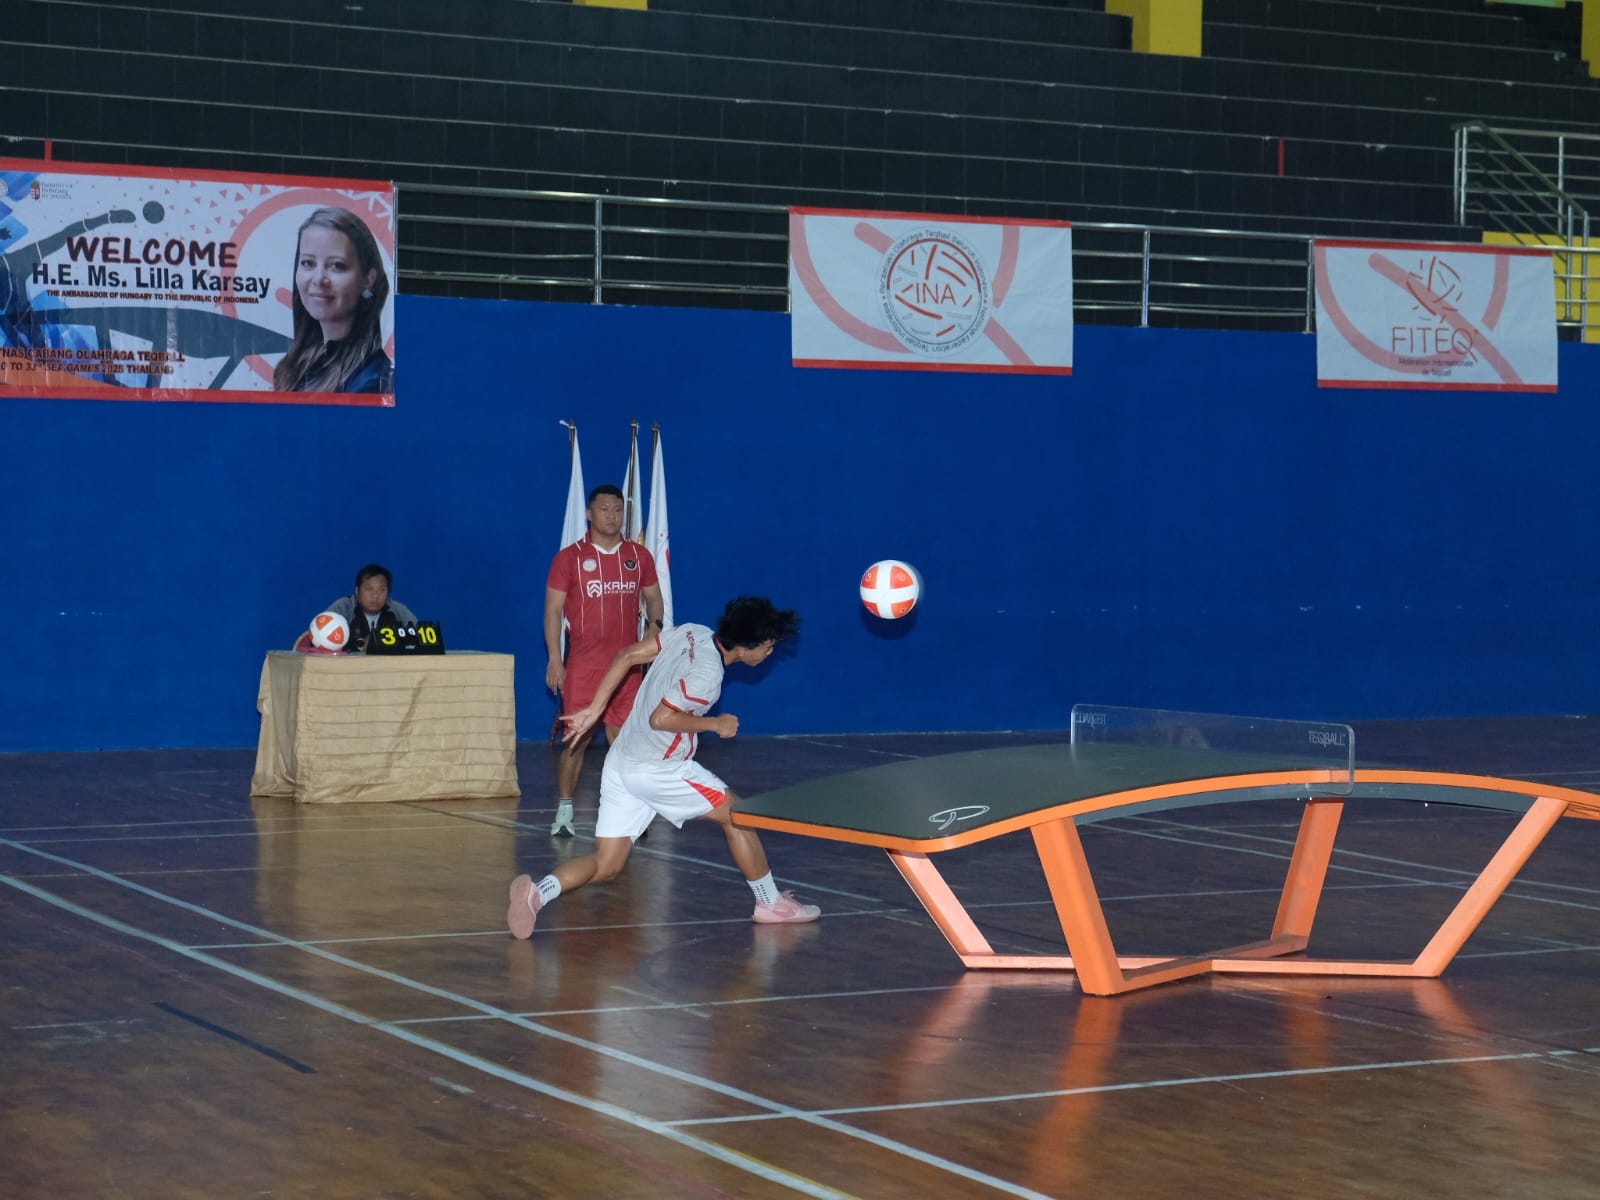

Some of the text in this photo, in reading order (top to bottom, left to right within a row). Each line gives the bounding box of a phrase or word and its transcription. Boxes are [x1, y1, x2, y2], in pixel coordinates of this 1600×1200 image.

[66, 235, 238, 268] WELCOME
[32, 262, 271, 299] H.E. Ms. Lilla Karsay
[46, 289, 60, 297] THE
[61, 290, 108, 298] AMBASSADOR
[120, 292, 152, 300] HUNGARY
[165, 293, 179, 301] THE
[180, 294, 212, 303] REPUBLIC
[223, 296, 259, 304] INDONESIA
[916, 282, 957, 305] INA
[1392, 326, 1478, 362] FITEQ
[0, 347, 24, 358] NAS
[76, 349, 135, 361] OLAHRAGA
[11, 362, 23, 371] TO
[66, 363, 99, 372] GAMES
[380, 627, 397, 645] 3
[418, 626, 437, 644] 10
[1308, 730, 1345, 748] TEQBALL
